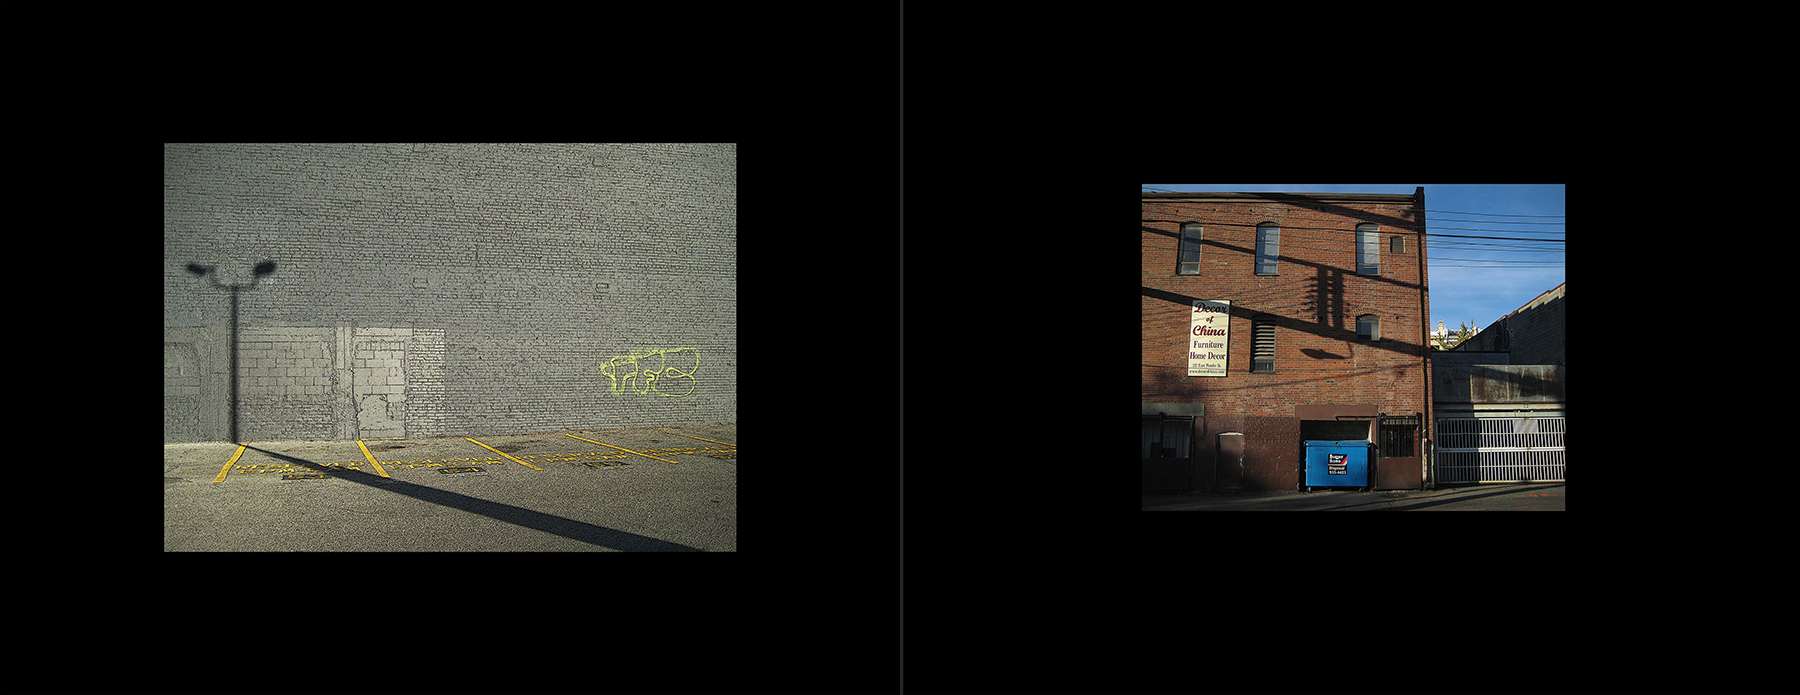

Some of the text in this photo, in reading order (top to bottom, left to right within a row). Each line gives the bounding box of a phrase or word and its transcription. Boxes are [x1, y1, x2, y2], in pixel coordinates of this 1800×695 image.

[1194, 302, 1228, 313] Decor
[1206, 315, 1214, 324] of
[1192, 325, 1226, 336] China
[1193, 340, 1224, 348] Furniture
[1190, 352, 1226, 360] Home Decor
